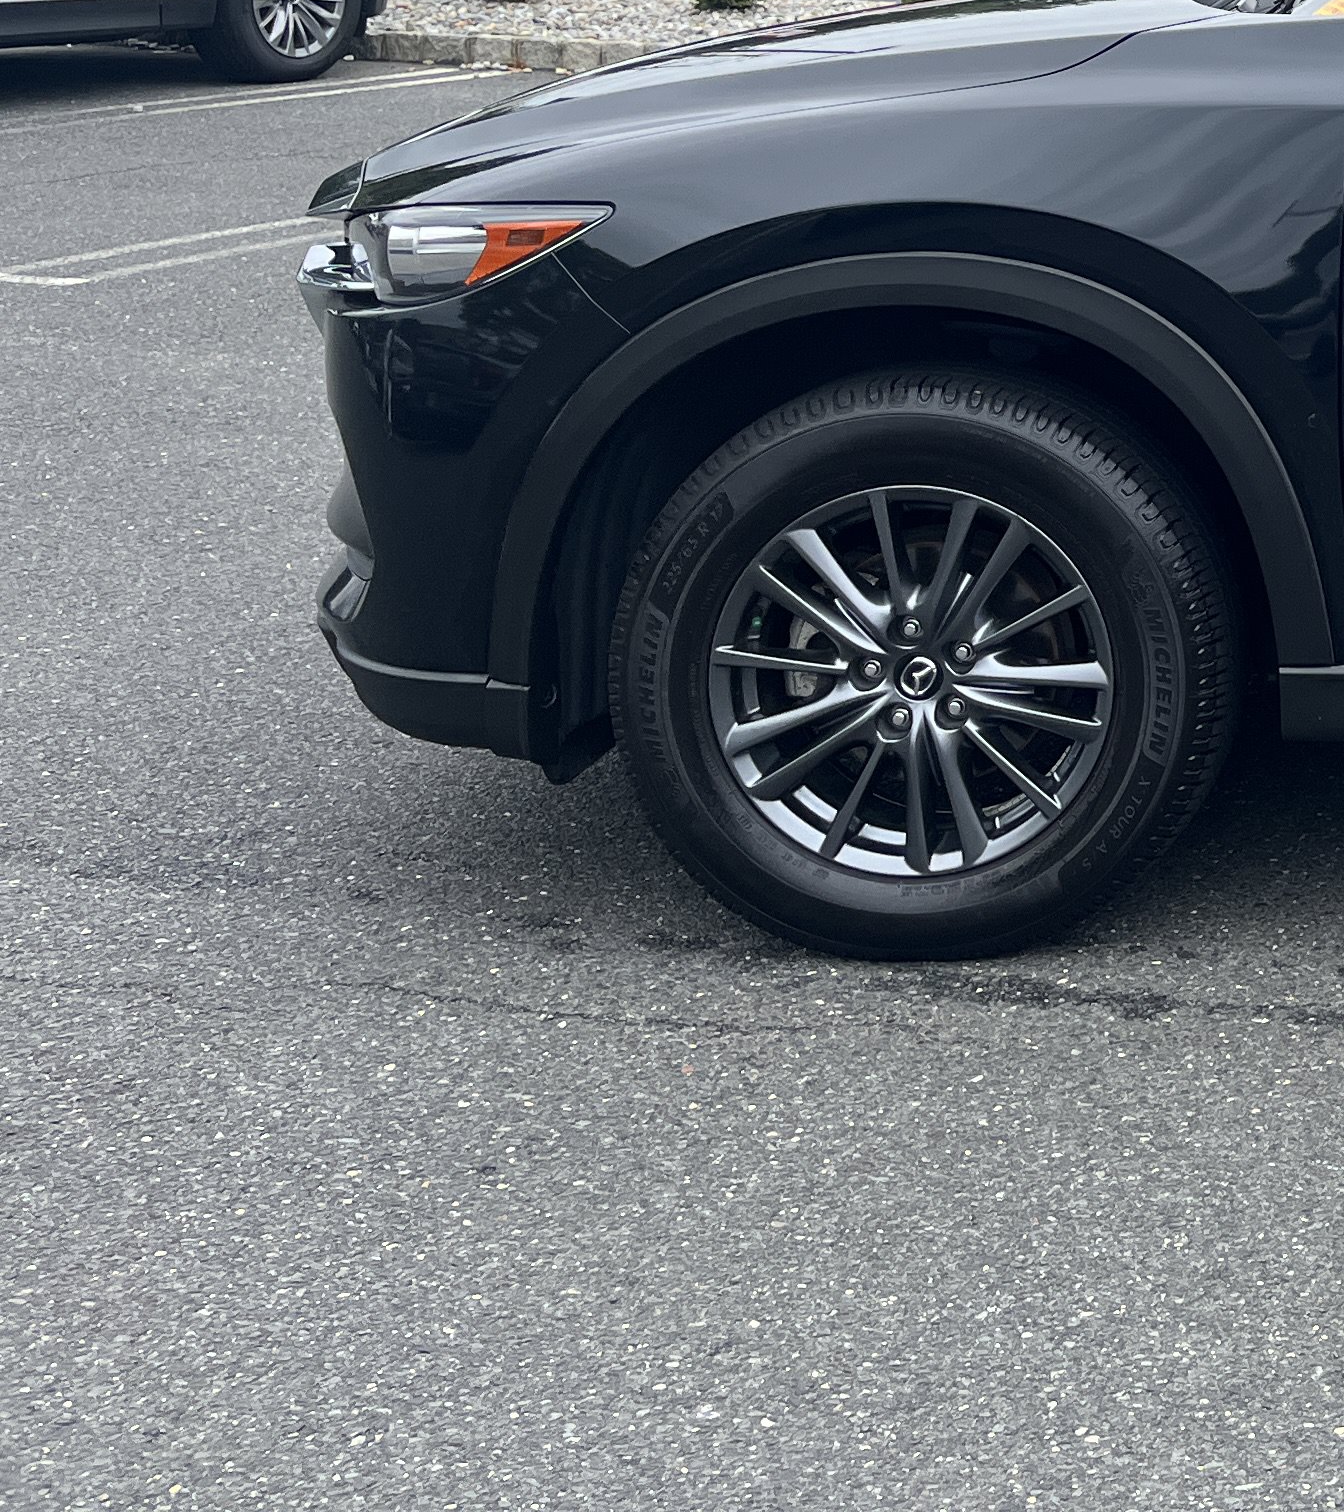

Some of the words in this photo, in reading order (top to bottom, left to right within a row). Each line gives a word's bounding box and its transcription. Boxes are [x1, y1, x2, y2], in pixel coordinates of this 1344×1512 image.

[637, 610, 669, 763] MICHELIN
[1143, 608, 1173, 756] MICHELIN
[1108, 795, 1143, 840] TOUR
